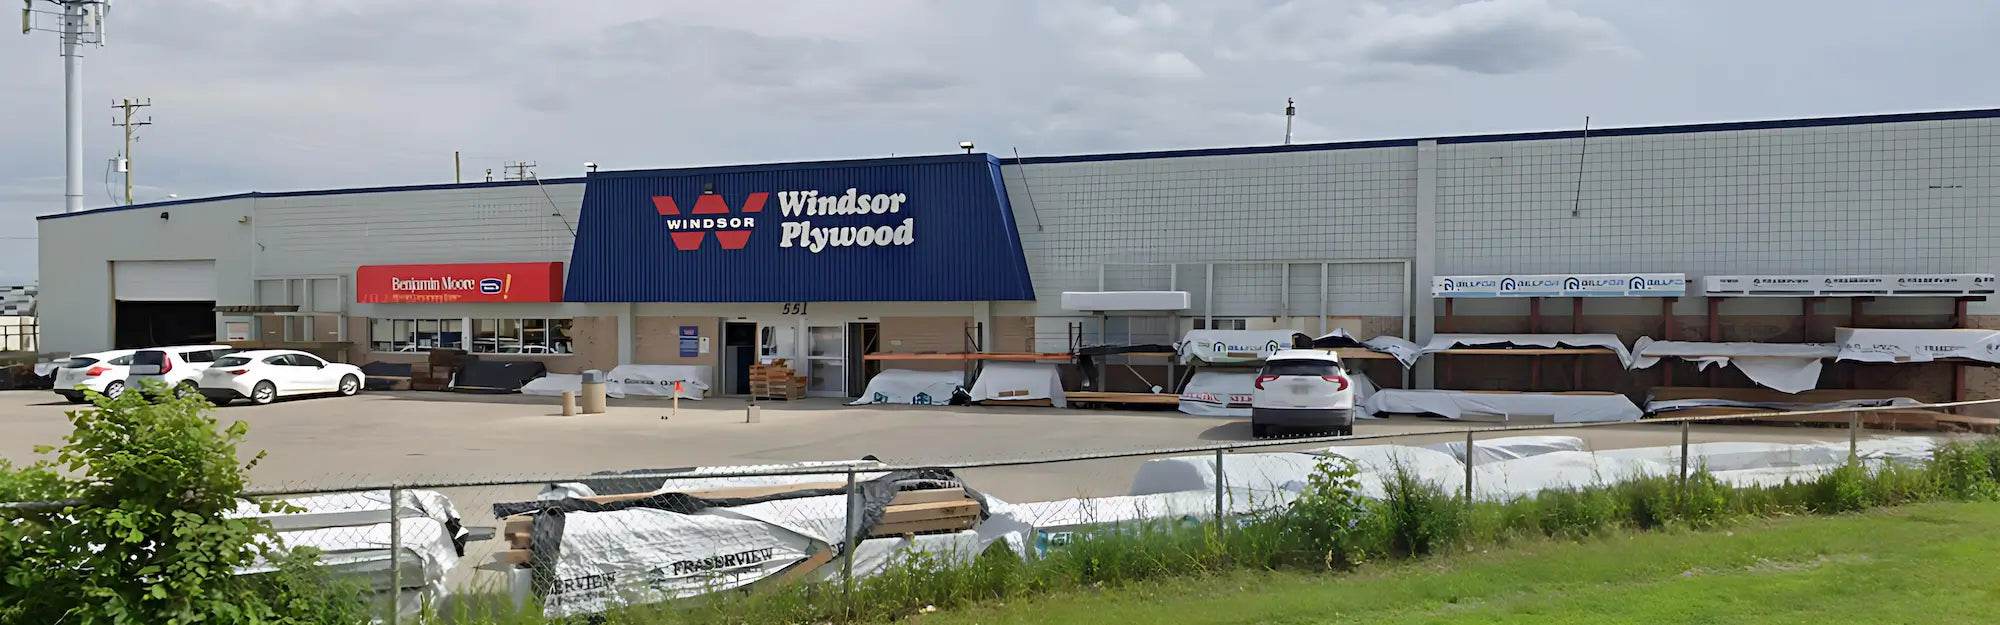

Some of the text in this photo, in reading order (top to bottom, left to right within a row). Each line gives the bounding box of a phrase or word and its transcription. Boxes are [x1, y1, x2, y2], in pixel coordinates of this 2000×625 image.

[777, 187, 906, 217] Windsor
[667, 217, 755, 230] WINDSOR
[779, 218, 914, 253] Plywood
[392, 276, 475, 292] Benjamin Moore
[782, 302, 808, 316] 551
[671, 547, 774, 576] FRASERVIEW
[548, 571, 617, 595] ERVIEW
